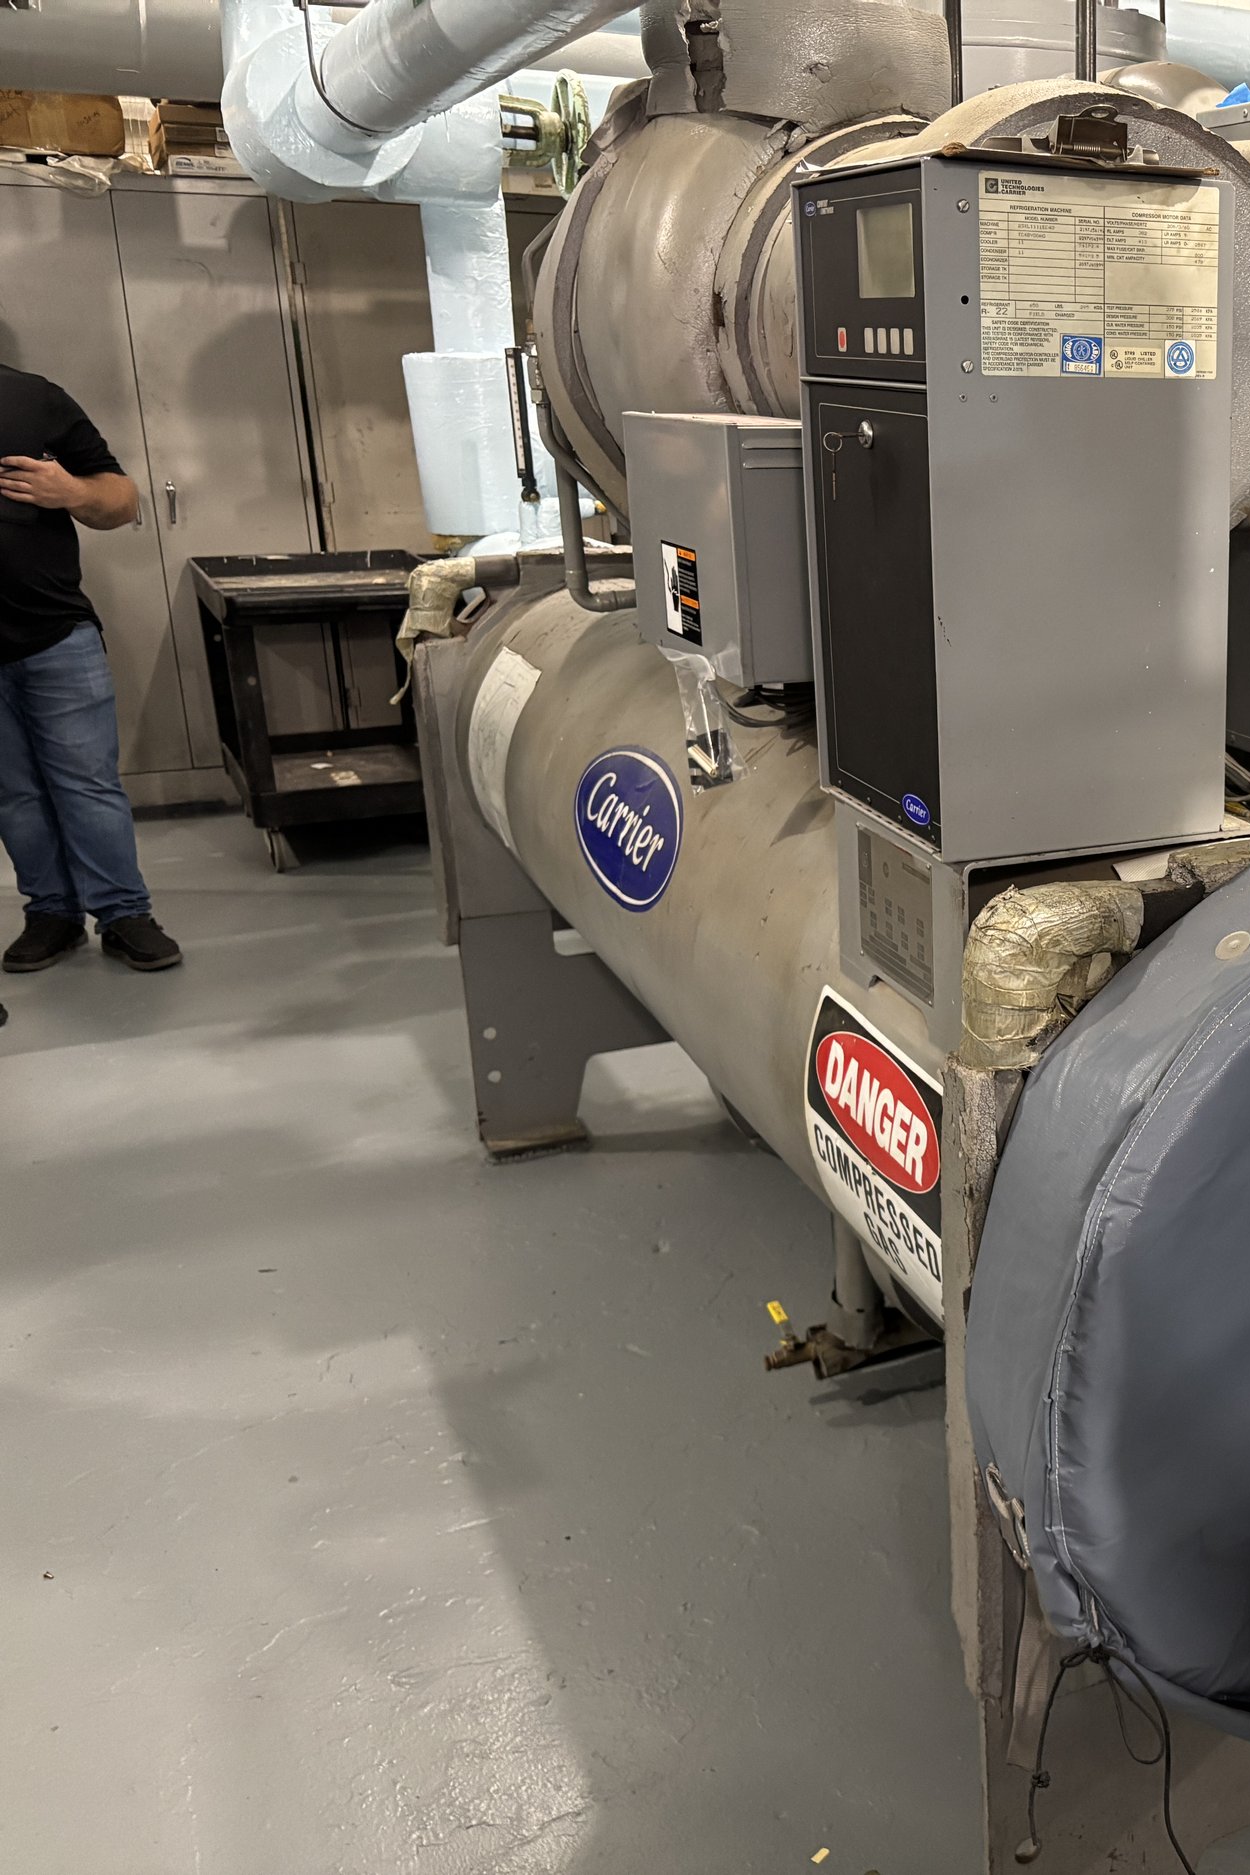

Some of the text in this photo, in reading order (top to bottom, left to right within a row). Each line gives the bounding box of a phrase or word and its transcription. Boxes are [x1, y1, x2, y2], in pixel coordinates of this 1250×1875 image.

[1000, 184, 1045, 192] TECHNOLOGIES
[1009, 205, 1049, 213] REFRIGERATION
[587, 772, 664, 872] Carrier
[906, 799, 927, 818] Carrier
[824, 1039, 928, 1186] DANGER
[814, 1123, 942, 1282] COMPRESSED
[864, 1212, 908, 1276] GAS
